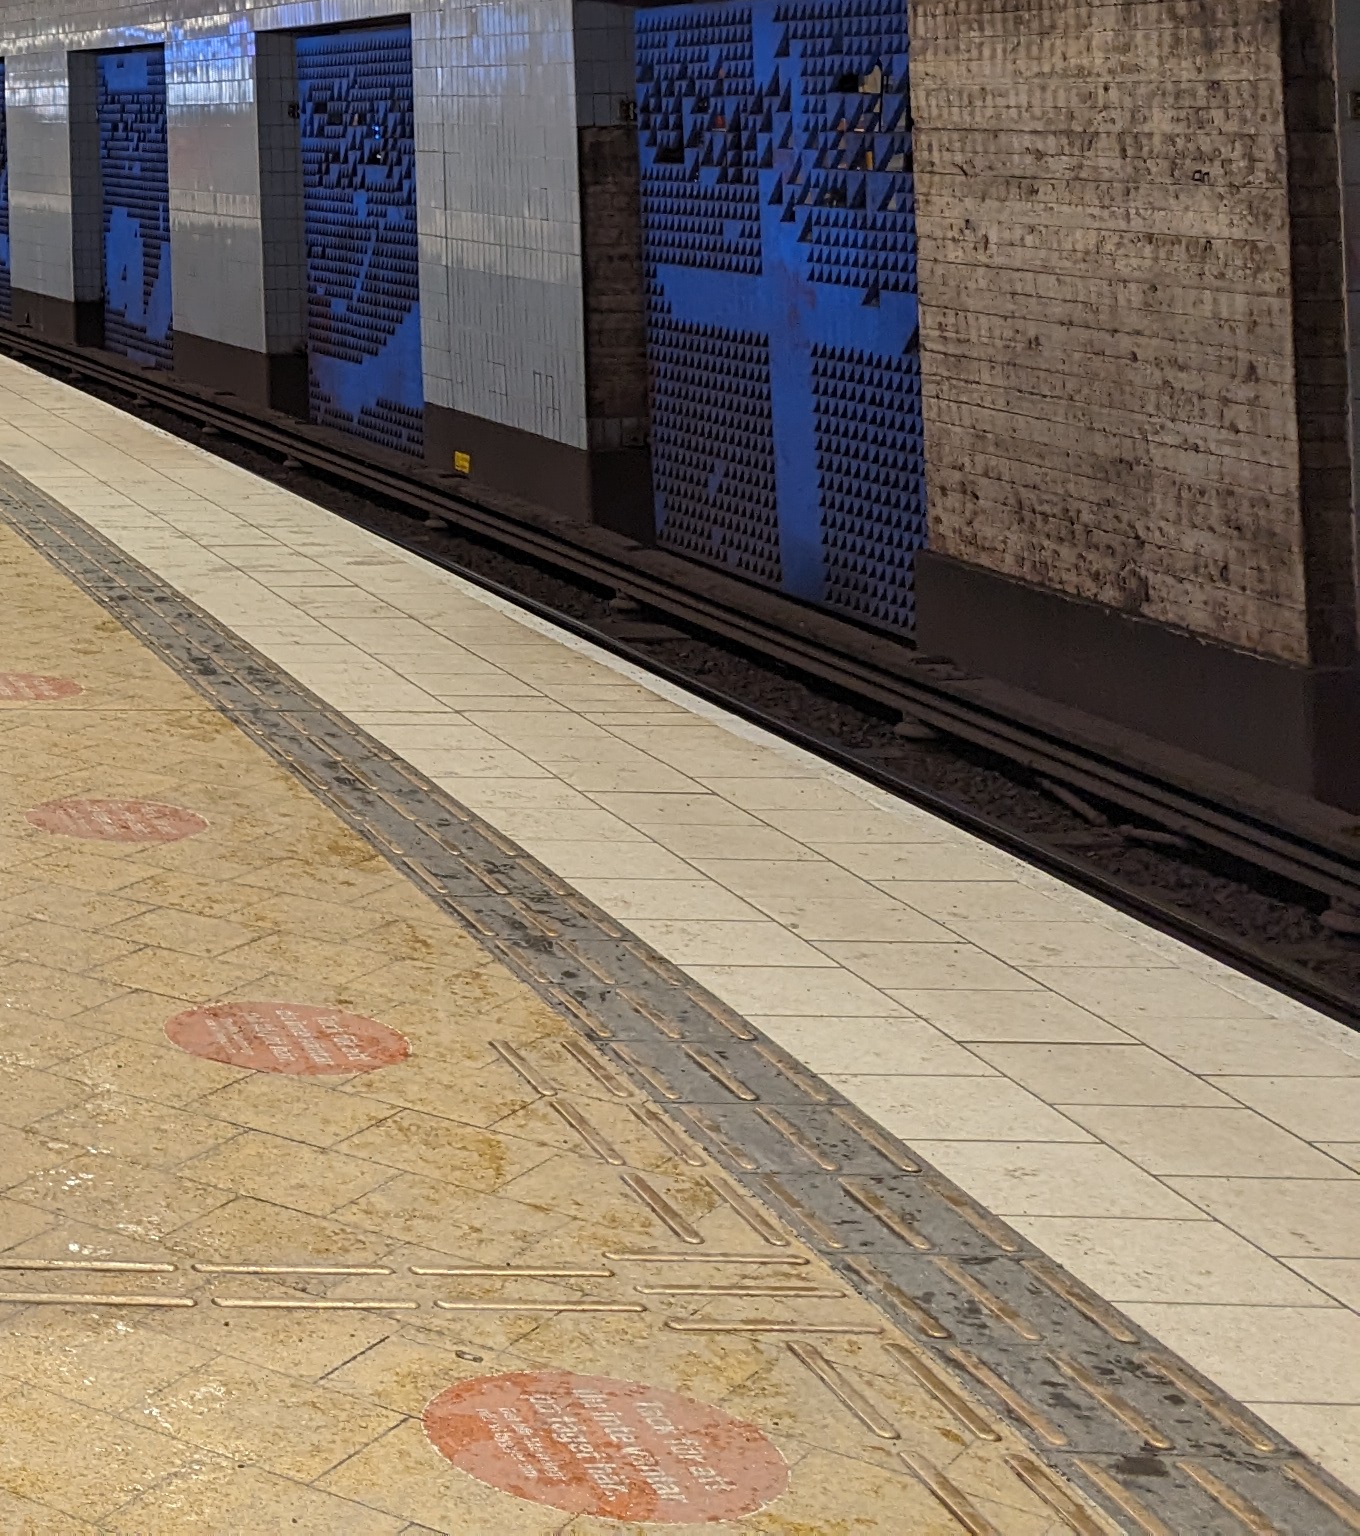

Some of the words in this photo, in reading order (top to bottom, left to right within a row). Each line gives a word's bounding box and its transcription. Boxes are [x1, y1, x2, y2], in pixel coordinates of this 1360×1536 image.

[591, 1411, 637, 1442] inte
[622, 1446, 689, 1503] väntar
[633, 1401, 683, 1434] Tack
[663, 1438, 706, 1462] för
[688, 1466, 737, 1491] att
